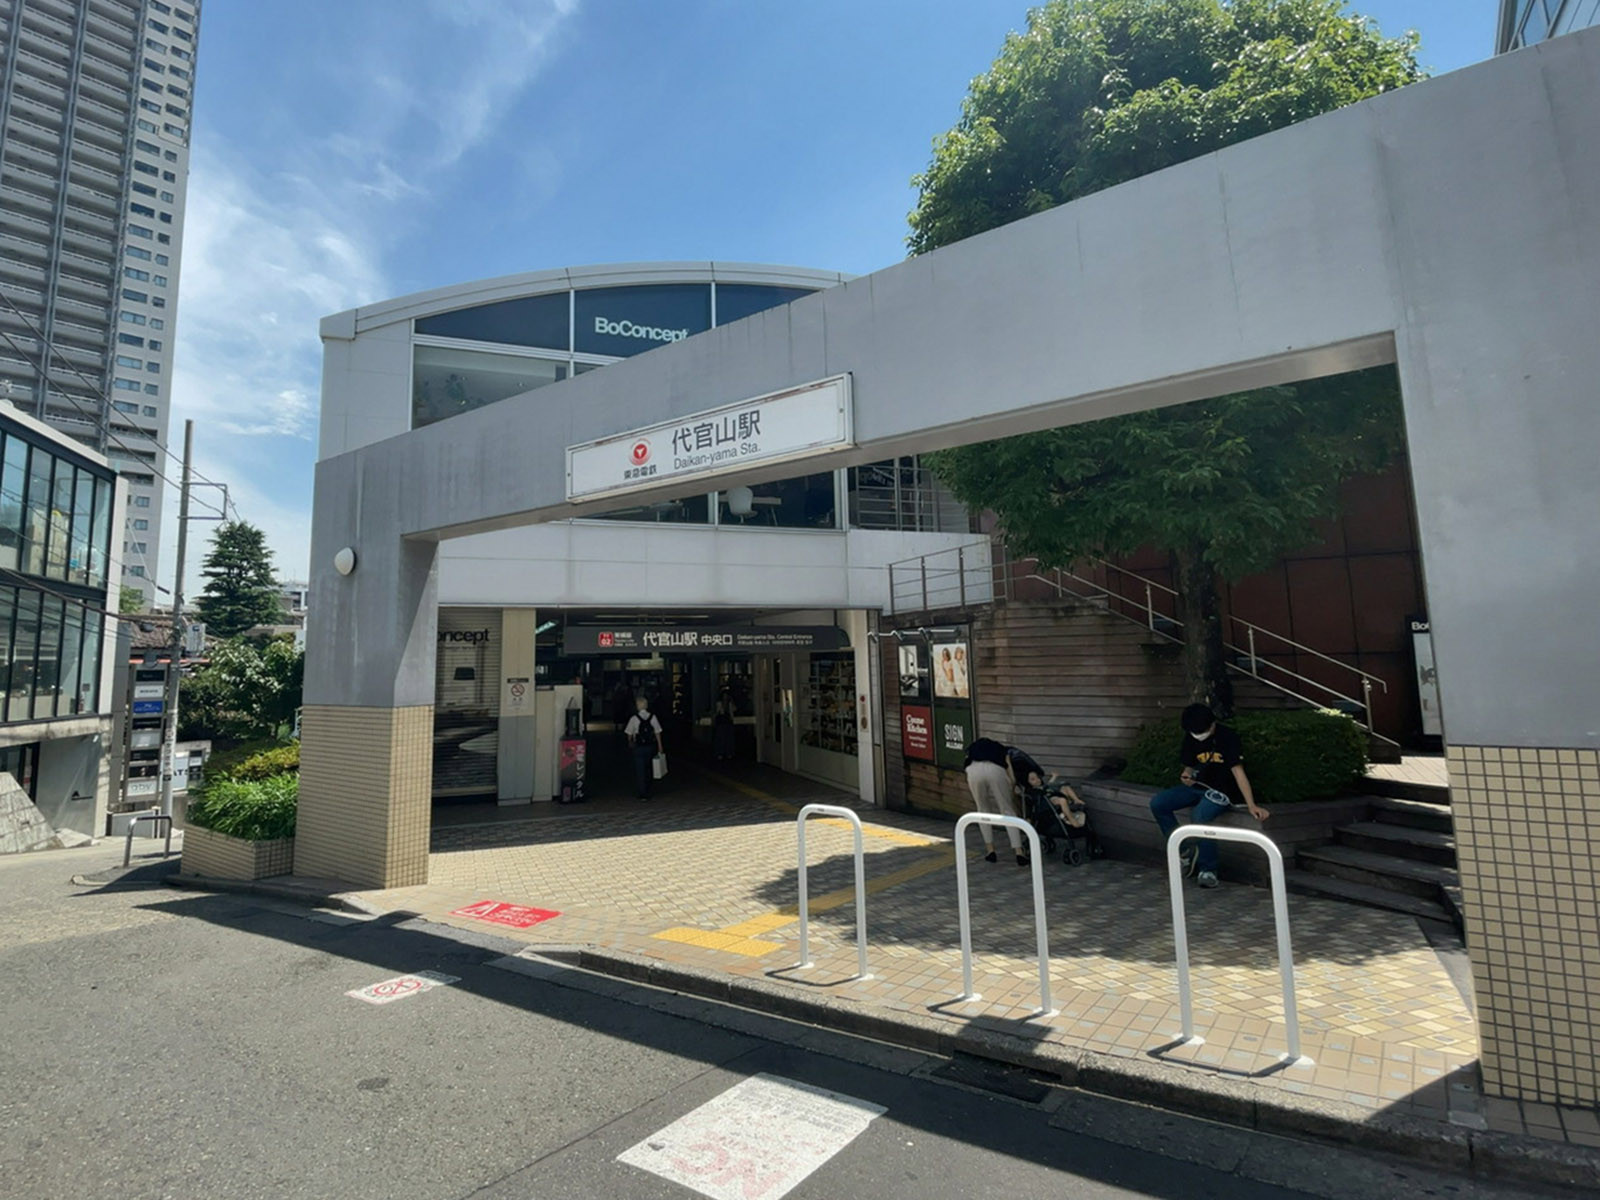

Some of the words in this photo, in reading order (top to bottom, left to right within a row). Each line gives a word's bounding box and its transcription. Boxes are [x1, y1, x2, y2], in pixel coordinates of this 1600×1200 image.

[594, 316, 689, 343] BoConcept
[672, 409, 761, 455] 代官山駅
[673, 448, 738, 470] Daikan-yama
[740, 441, 761, 456] Sta.
[643, 632, 698, 646] 代官山駅
[701, 634, 733, 646] 中央口
[944, 724, 963, 742] SIGN
